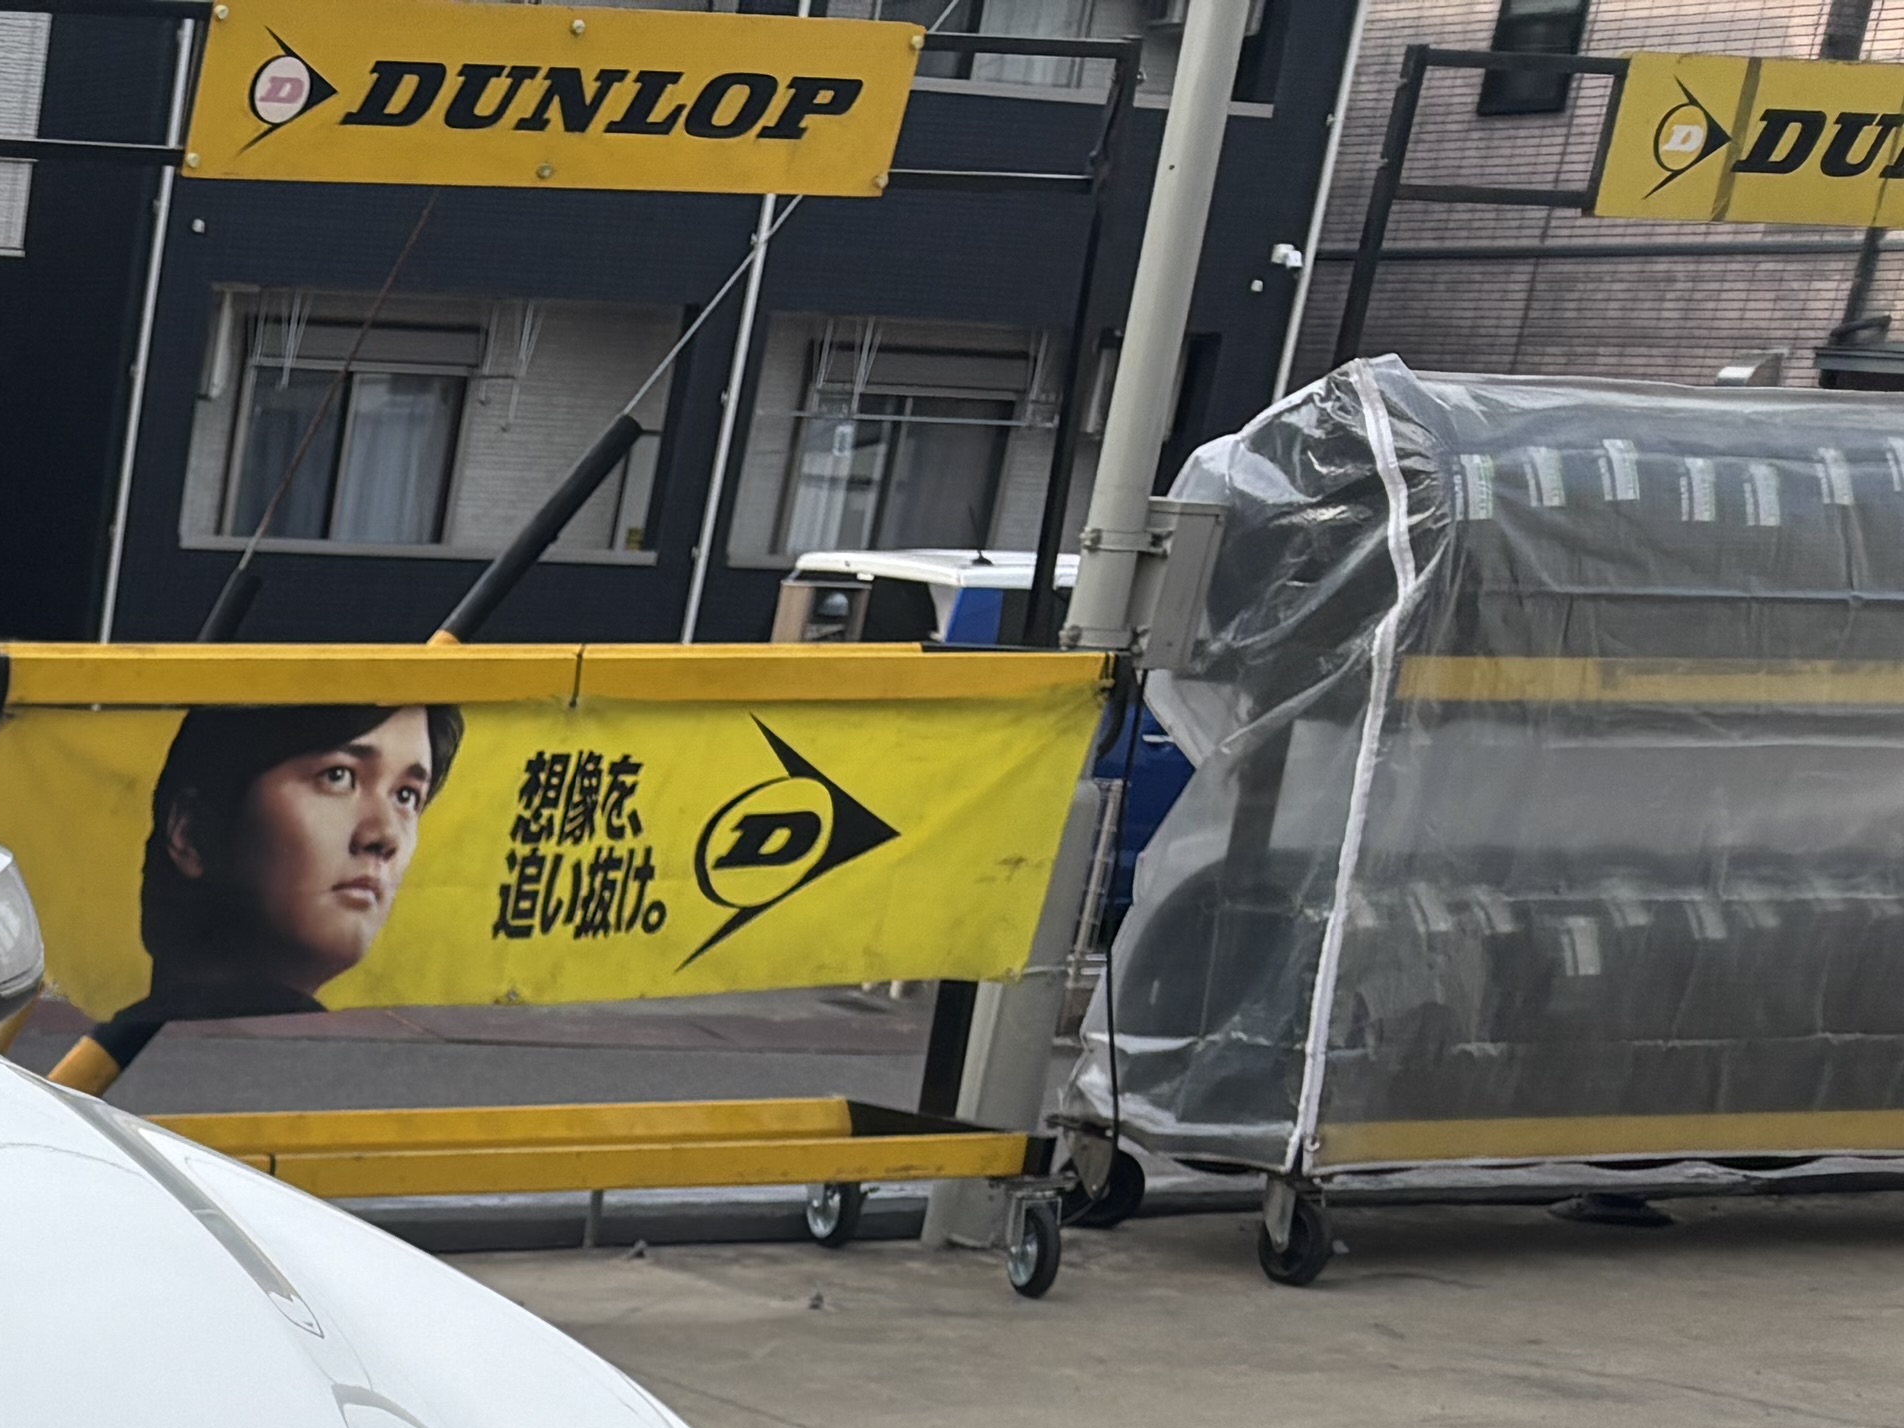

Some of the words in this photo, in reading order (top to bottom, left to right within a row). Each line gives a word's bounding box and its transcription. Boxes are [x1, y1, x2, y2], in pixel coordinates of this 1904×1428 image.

[339, 60, 864, 140] DUNLOP
[1730, 108, 1904, 179] DU
[510, 750, 643, 846] 想像を、
[711, 811, 822, 871] D
[492, 845, 668, 940] 追い抜け。
